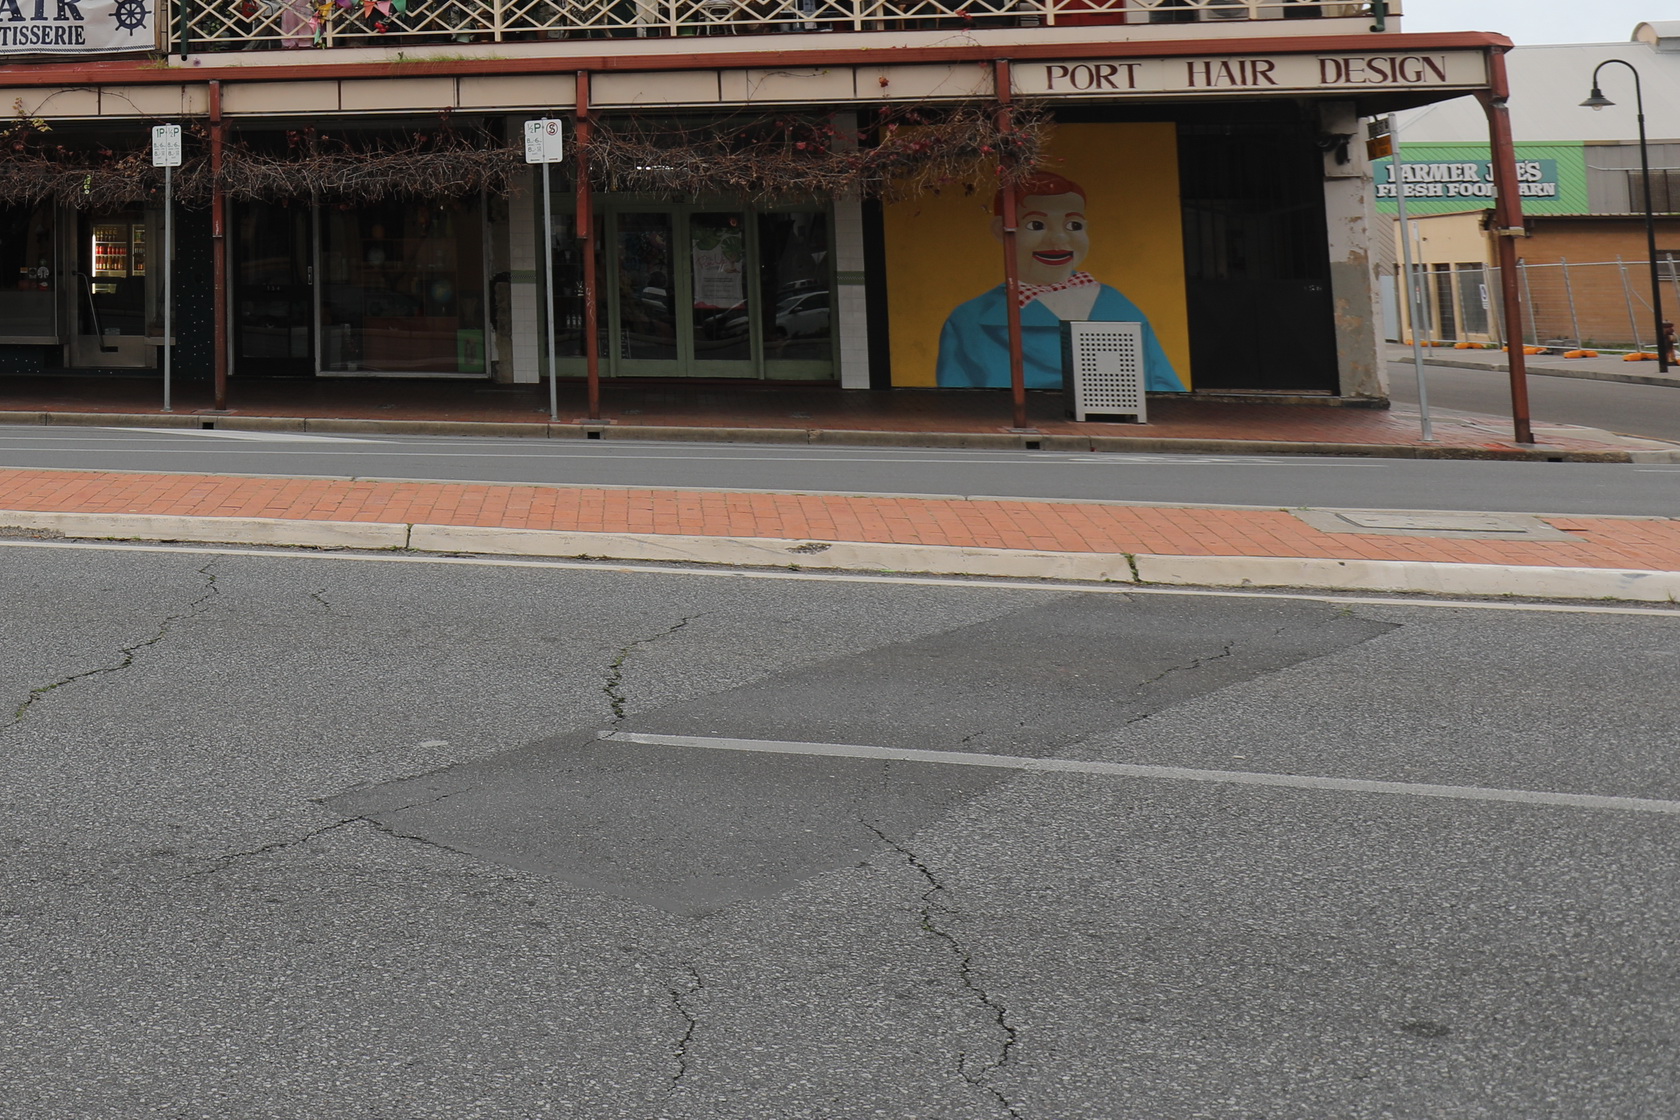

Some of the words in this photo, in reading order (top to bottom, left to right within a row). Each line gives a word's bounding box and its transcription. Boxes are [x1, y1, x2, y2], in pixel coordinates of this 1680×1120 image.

[1045, 63, 1142, 91] PORT
[1187, 59, 1278, 88] HAIR
[1317, 55, 1447, 85] DESIGN
[1518, 183, 1556, 197] ARN
